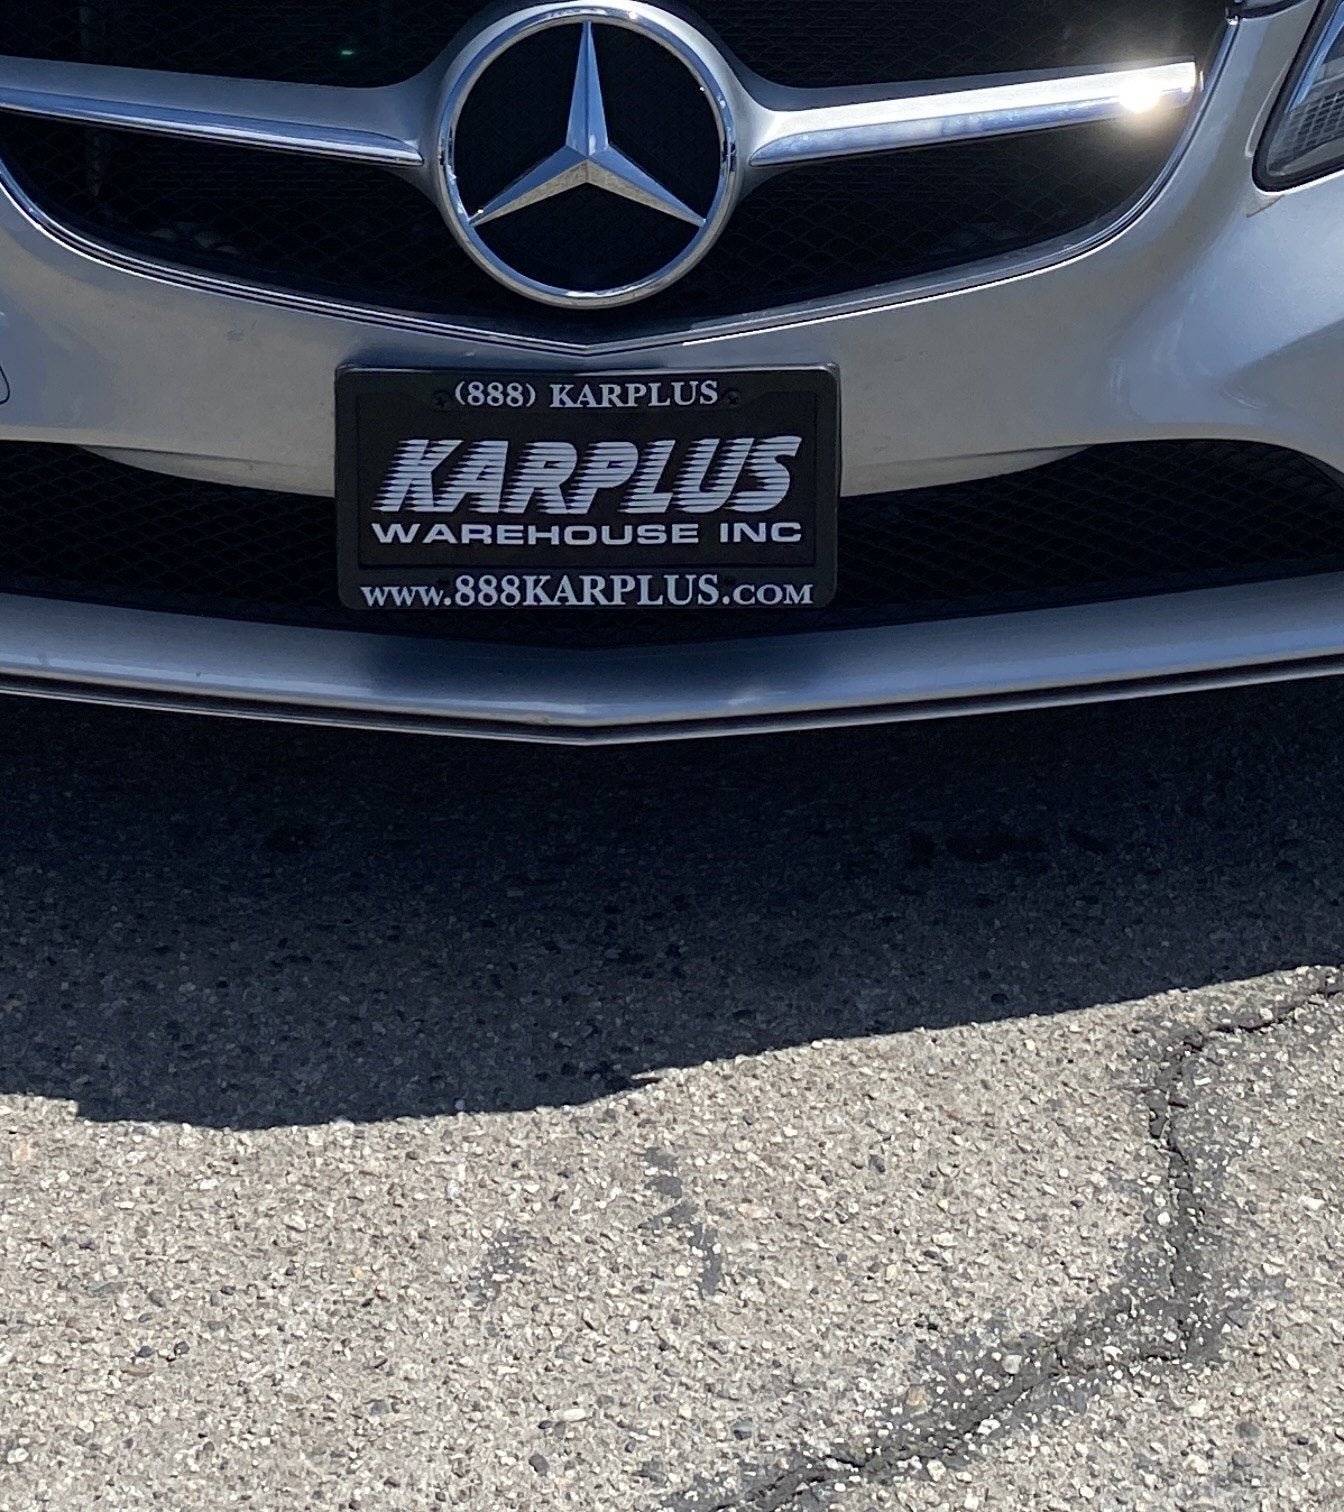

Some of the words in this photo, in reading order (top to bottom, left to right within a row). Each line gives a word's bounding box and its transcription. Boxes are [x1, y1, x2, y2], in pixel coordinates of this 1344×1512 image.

[454, 381, 537, 408] (888)
[549, 380, 719, 408] KARPLUS
[371, 435, 803, 515] KARPLUS
[371, 521, 700, 546] WAREHOUSE
[719, 521, 803, 544] INC
